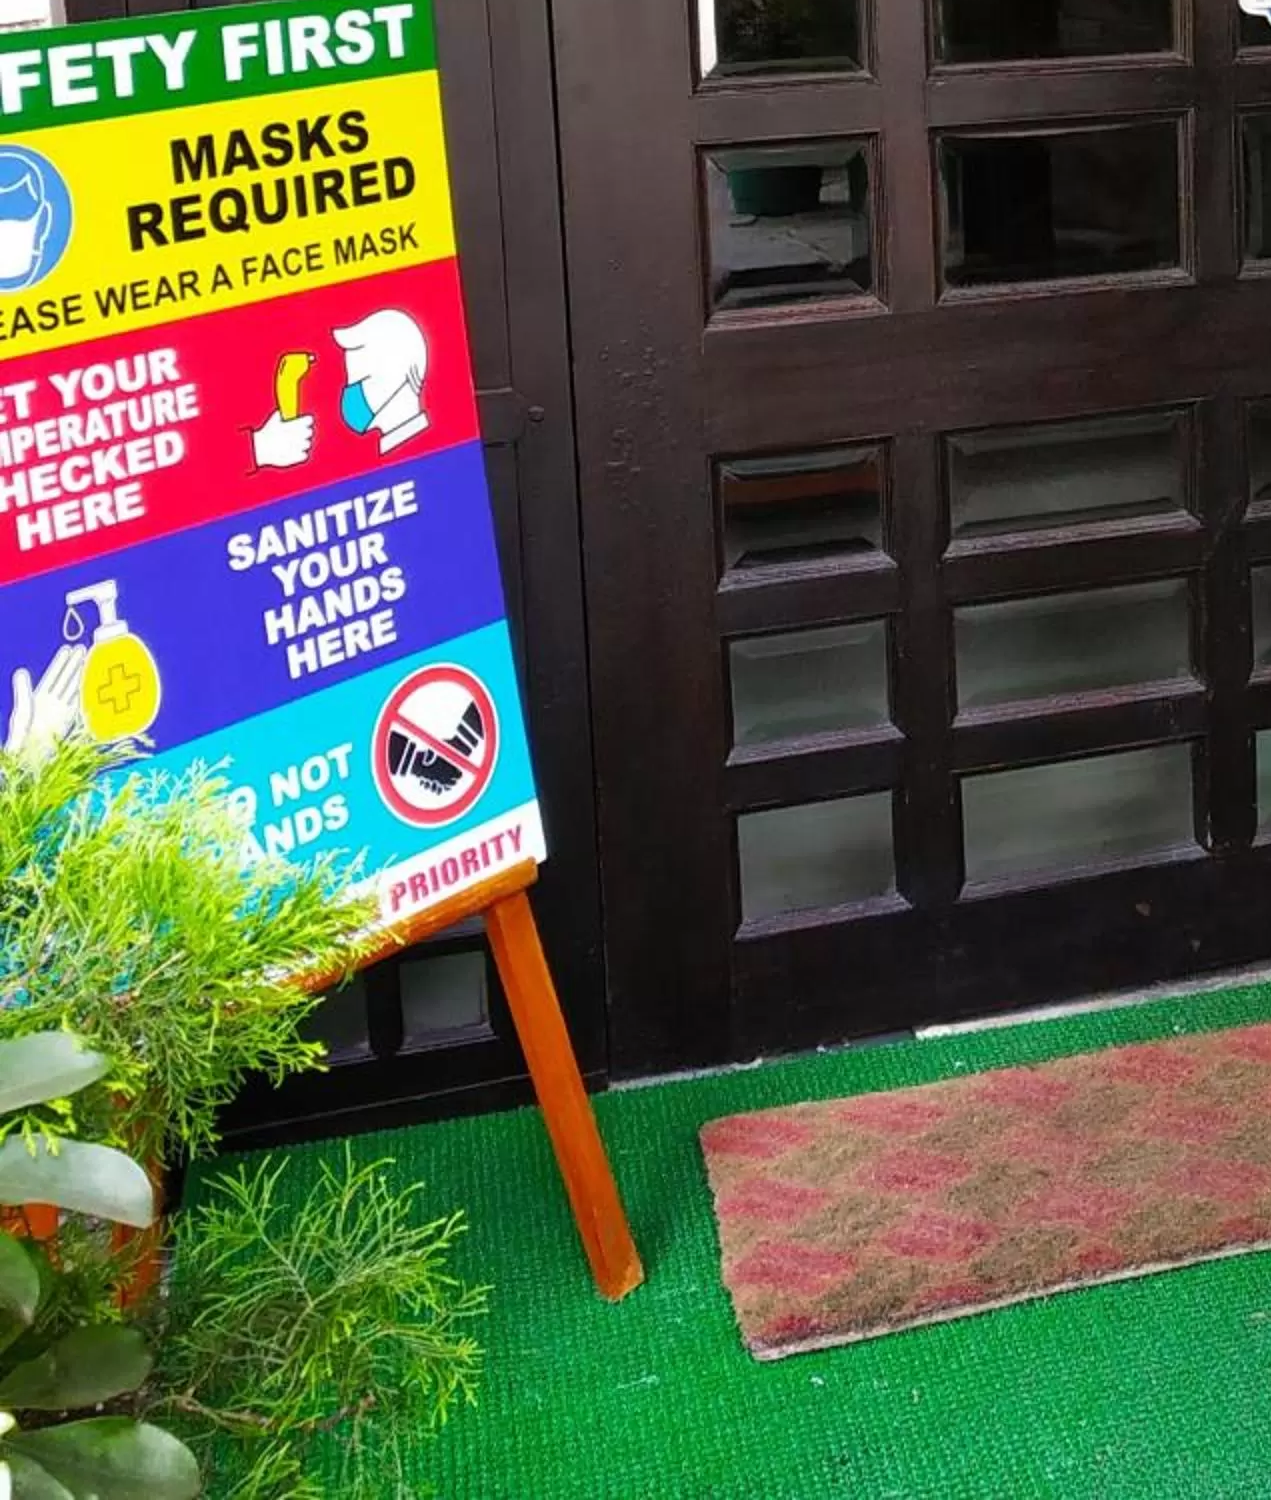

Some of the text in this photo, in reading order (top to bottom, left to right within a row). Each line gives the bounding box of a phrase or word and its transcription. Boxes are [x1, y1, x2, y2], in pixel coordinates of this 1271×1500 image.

[0, 2, 415, 116] FETY FIRST
[170, 108, 370, 185] MASKS
[126, 155, 418, 253] REQUIRED
[94, 270, 202, 319] WEAR
[211, 262, 234, 294] A
[241, 246, 325, 288] FACE
[333, 222, 420, 266] MASK
[48, 347, 182, 410] YOUR
[16, 481, 147, 553] HERE
[226, 480, 419, 572] SANITIZE
[271, 531, 389, 598] YOUR
[262, 567, 407, 646] HANDS
[286, 609, 398, 680] HERE
[268, 741, 354, 808] NOT
[236, 793, 350, 870] ANDS
[388, 822, 523, 913] PRIORITY
